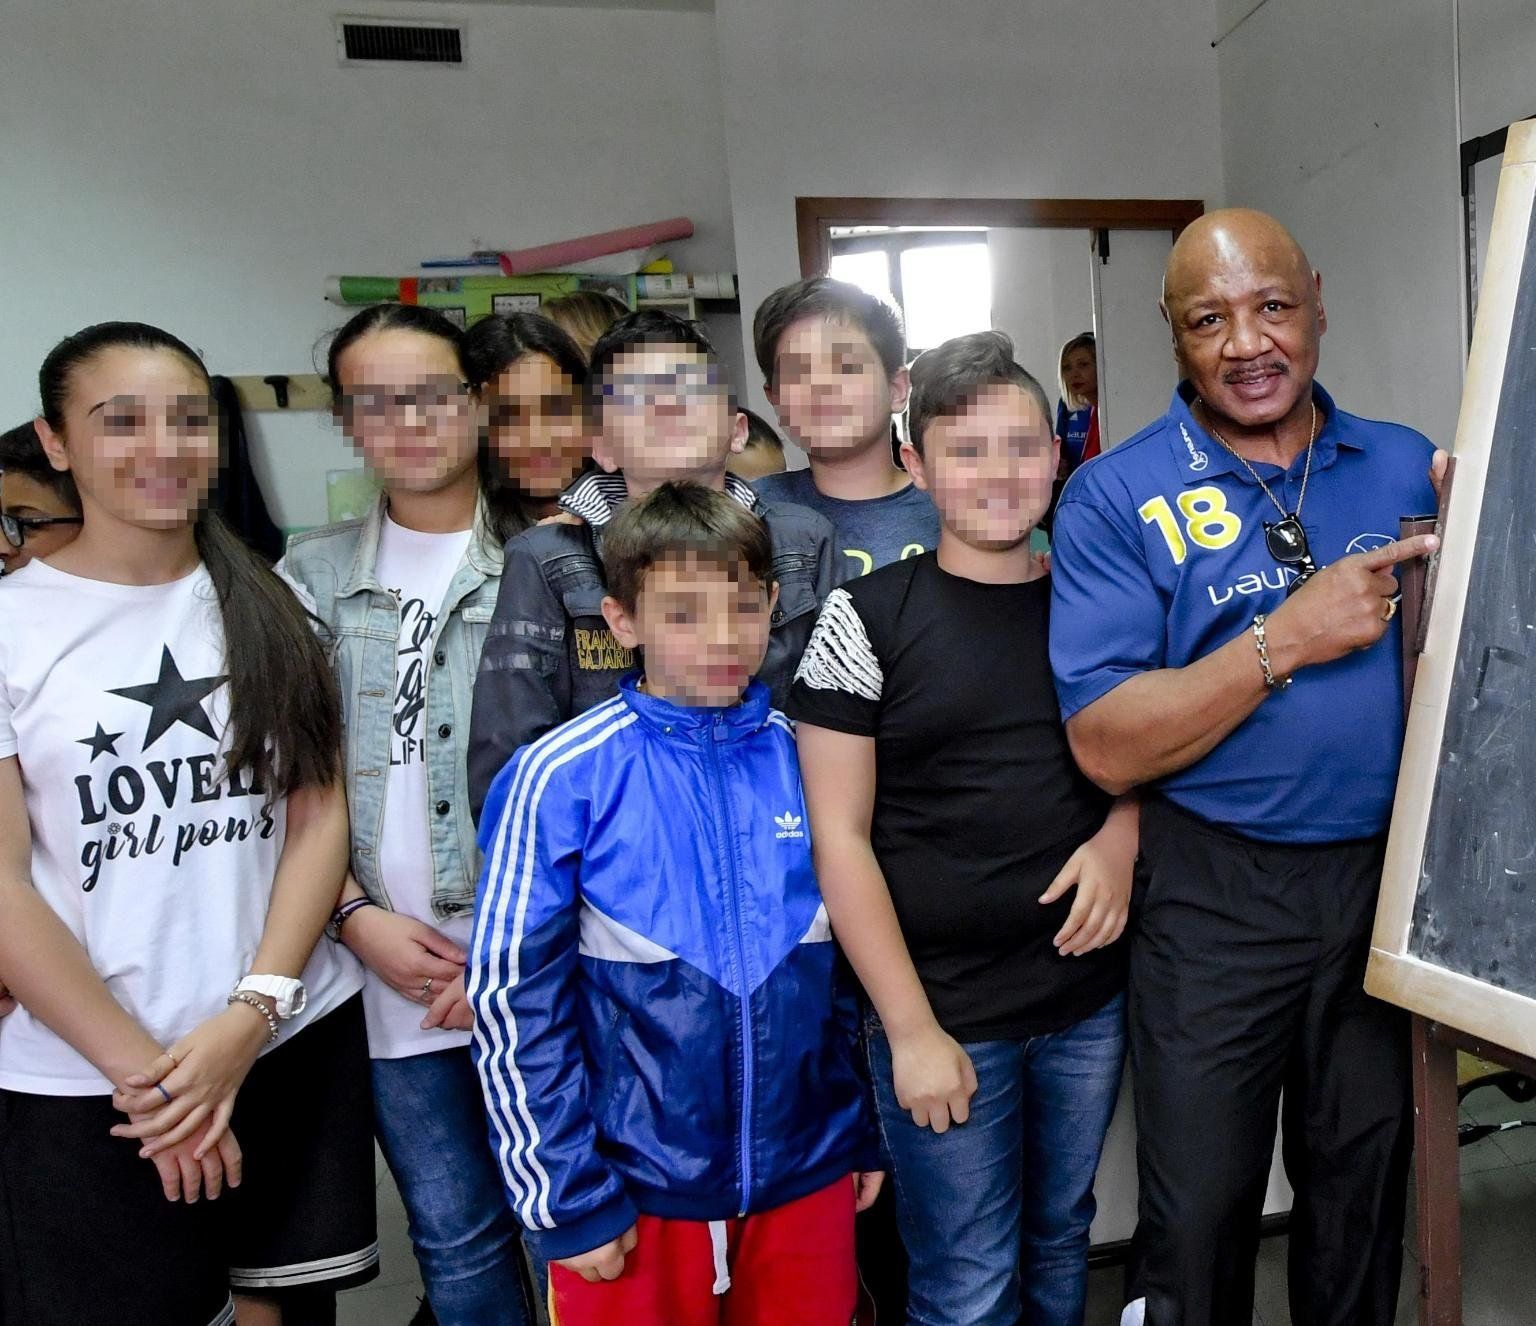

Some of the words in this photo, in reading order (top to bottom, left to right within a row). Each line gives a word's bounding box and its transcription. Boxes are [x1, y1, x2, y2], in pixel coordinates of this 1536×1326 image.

[1138, 486, 1242, 565] 18
[390, 738, 424, 766] LIF
[81, 814, 165, 892] girl
